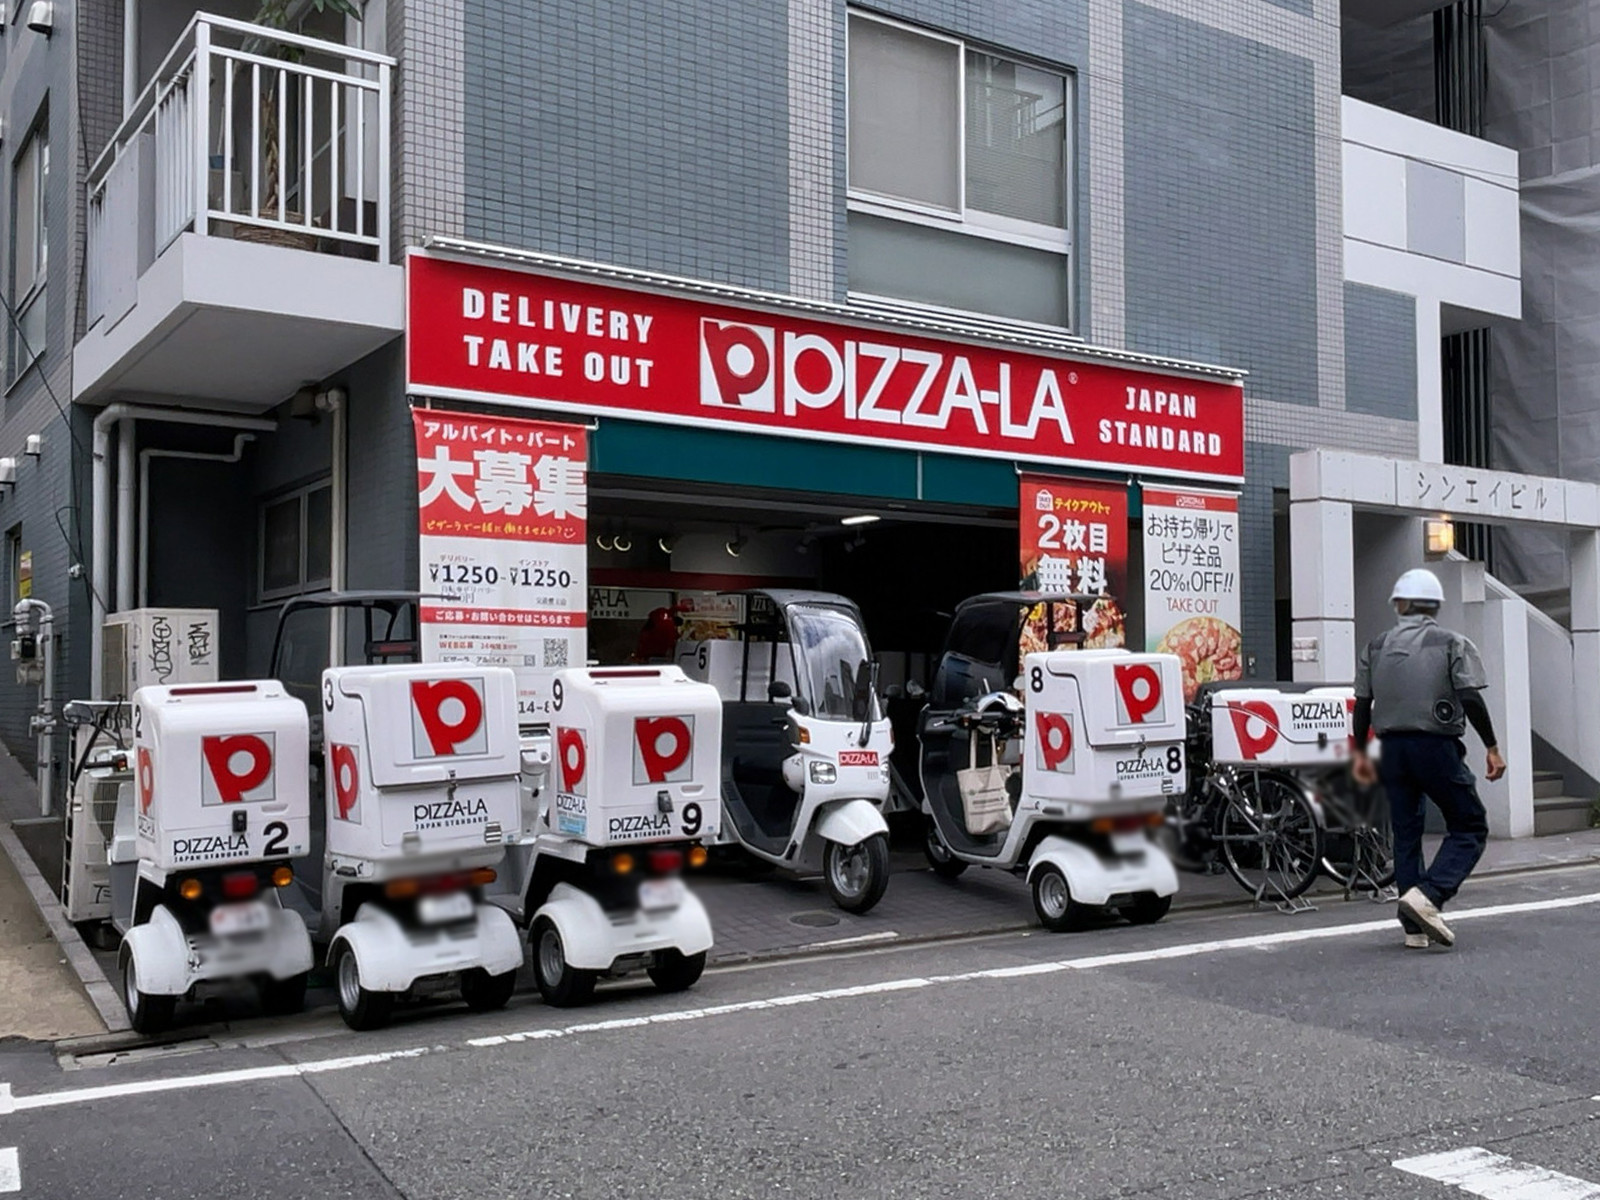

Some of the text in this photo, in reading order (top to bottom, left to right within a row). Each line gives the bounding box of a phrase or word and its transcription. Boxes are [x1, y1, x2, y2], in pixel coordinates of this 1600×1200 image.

[462, 288, 653, 343] DELIVERY
[463, 335, 654, 387] TAKE OUT
[1125, 386, 1197, 419] JAPAN
[423, 421, 576, 451] アルバイト・パート
[1099, 419, 1222, 457] STANDARD
[418, 445, 587, 520] 大募集
[1418, 472, 1547, 510] シンエイビル
[1055, 497, 1111, 515] テイクアウトで
[1038, 513, 1108, 553] 2枚目
[1147, 513, 1233, 542] お持ち帰りで
[1162, 542, 1222, 568] ピザ全品
[1037, 554, 1108, 595] 無料
[590, 589, 629, 608] A-LA
[1166, 597, 1219, 613] TAKE OUT
[1030, 666, 1043, 693] 8
[324, 678, 334, 712] 3
[552, 678, 564, 712] 9
[135, 704, 142, 738] 2
[1291, 703, 1344, 721] PIZZA-LA
[1116, 757, 1164, 774] PIZZA-LA
[1166, 746, 1182, 774] 8
[414, 798, 488, 822] PIZZA-LA
[415, 816, 489, 831] JAPAN STANDARD
[682, 802, 702, 836] 9
[263, 821, 289, 857] 2
[609, 815, 670, 835] PIZZA-LA
[173, 834, 249, 856] PIZZA-LA
[174, 850, 249, 863] JAPAN STANDARD
